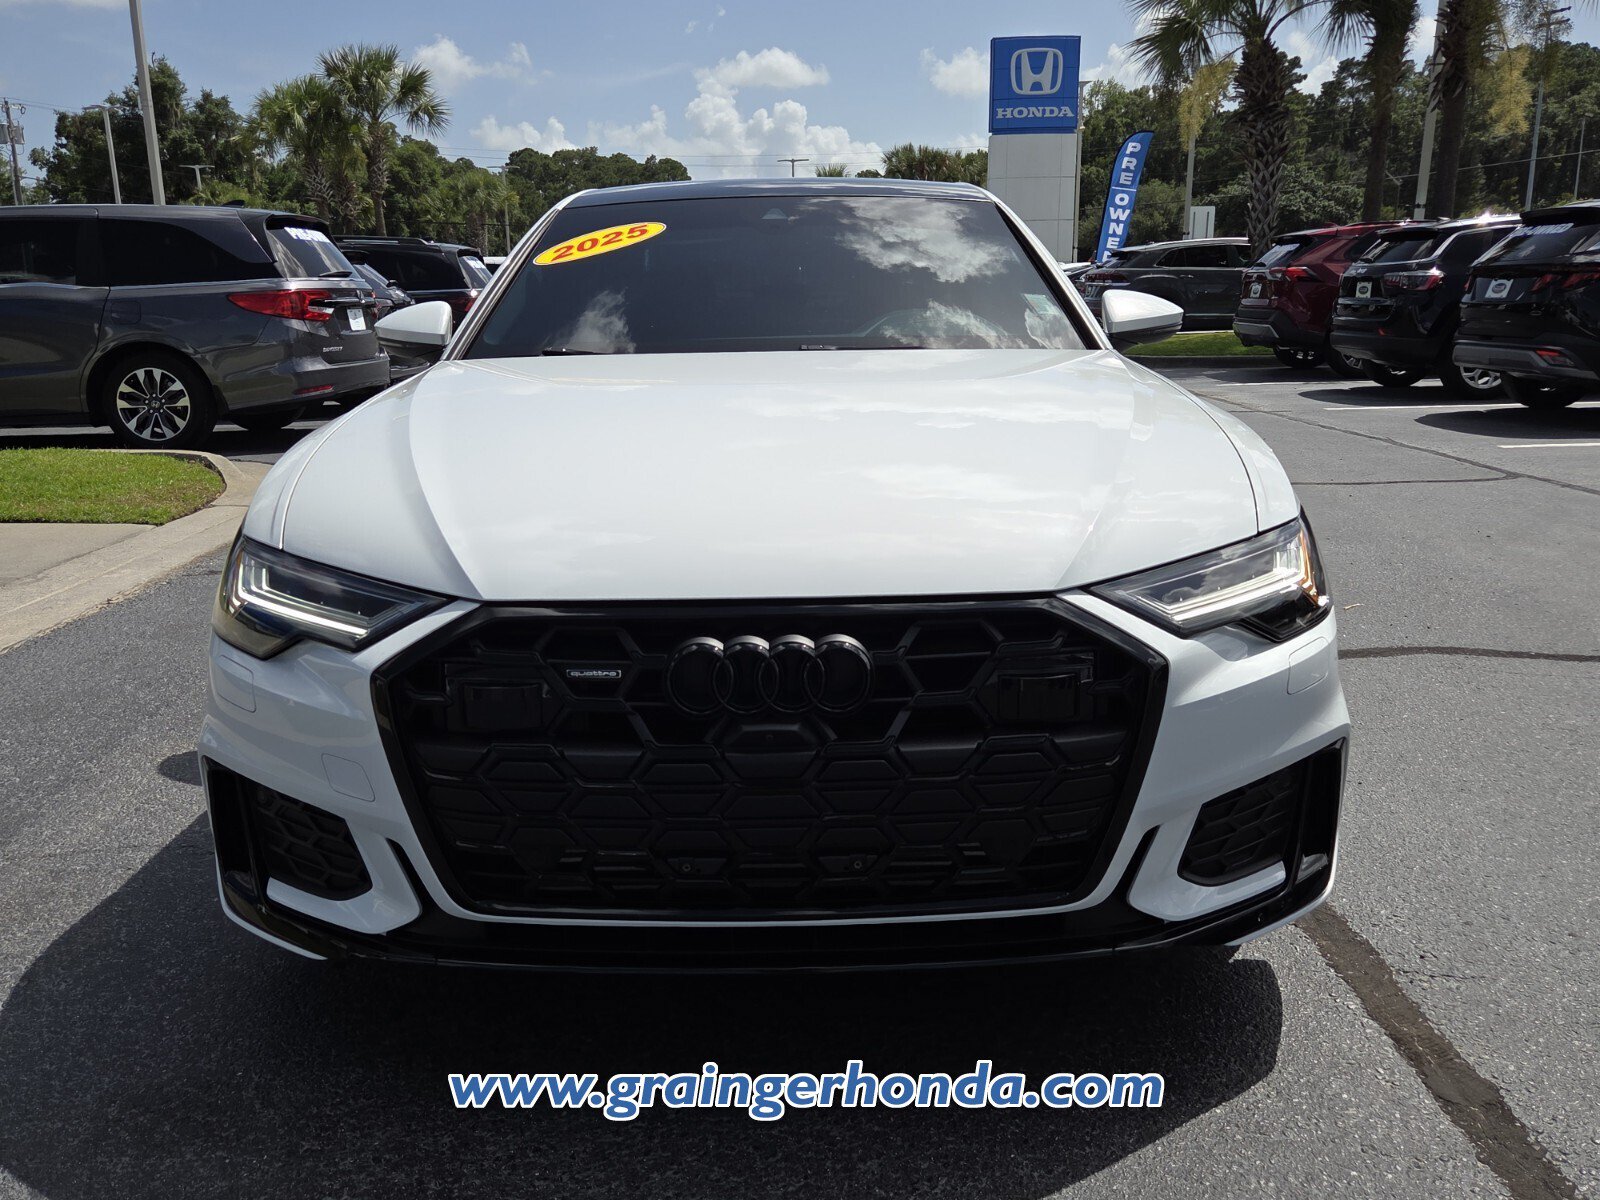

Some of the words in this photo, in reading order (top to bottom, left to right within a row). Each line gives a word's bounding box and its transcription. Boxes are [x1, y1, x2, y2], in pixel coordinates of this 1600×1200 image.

[996, 106, 1075, 119] HONDA
[1119, 142, 1141, 185] PRE
[550, 224, 649, 262] 2025
